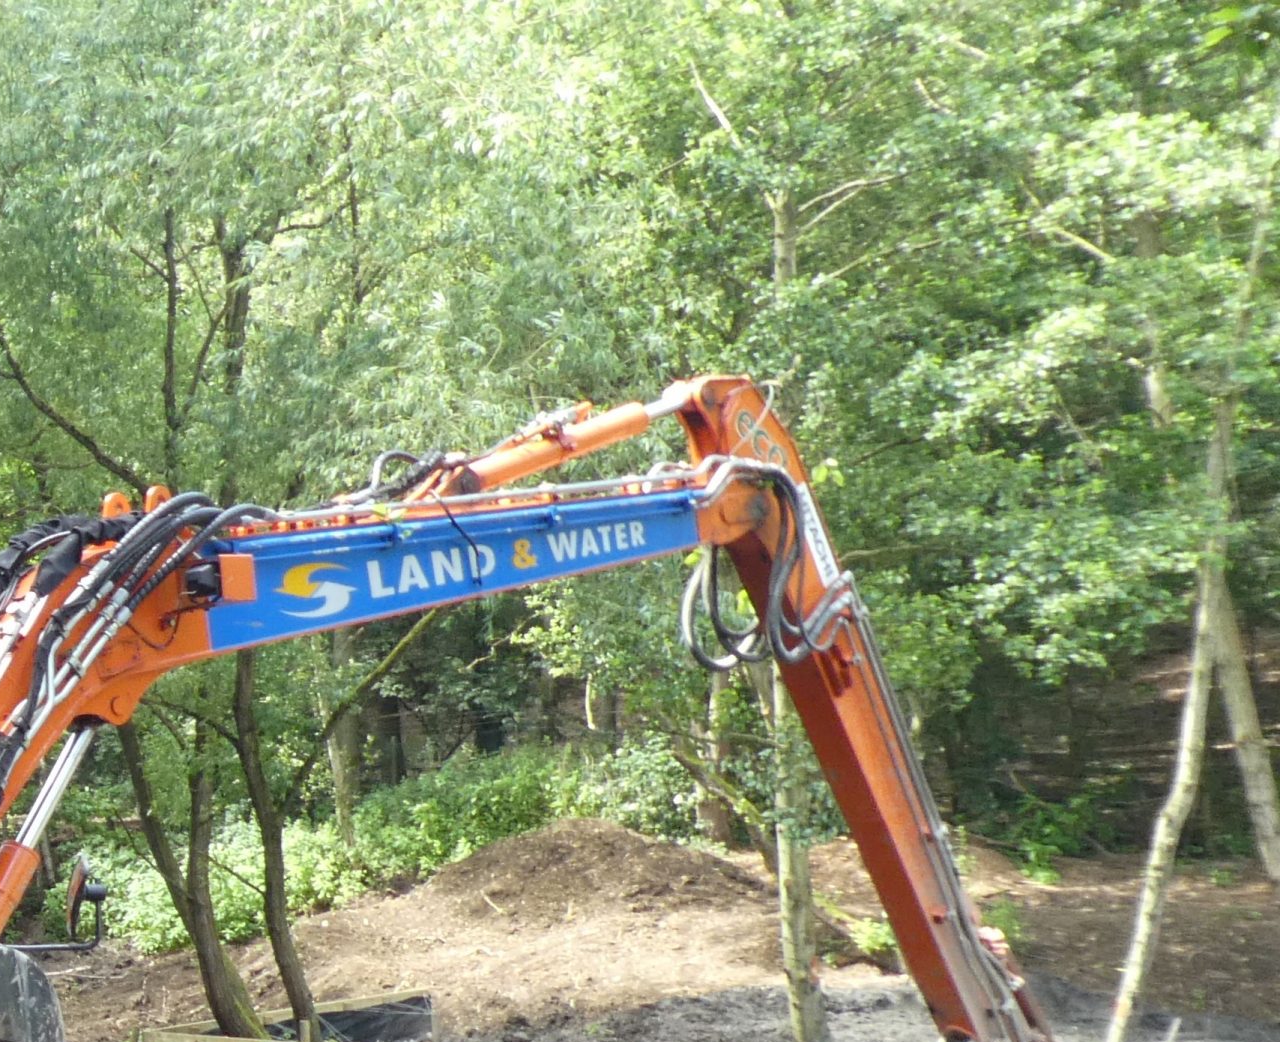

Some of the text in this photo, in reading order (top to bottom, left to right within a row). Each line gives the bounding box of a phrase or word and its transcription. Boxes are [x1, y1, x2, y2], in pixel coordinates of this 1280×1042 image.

[367, 521, 646, 599] LAND & WATER
